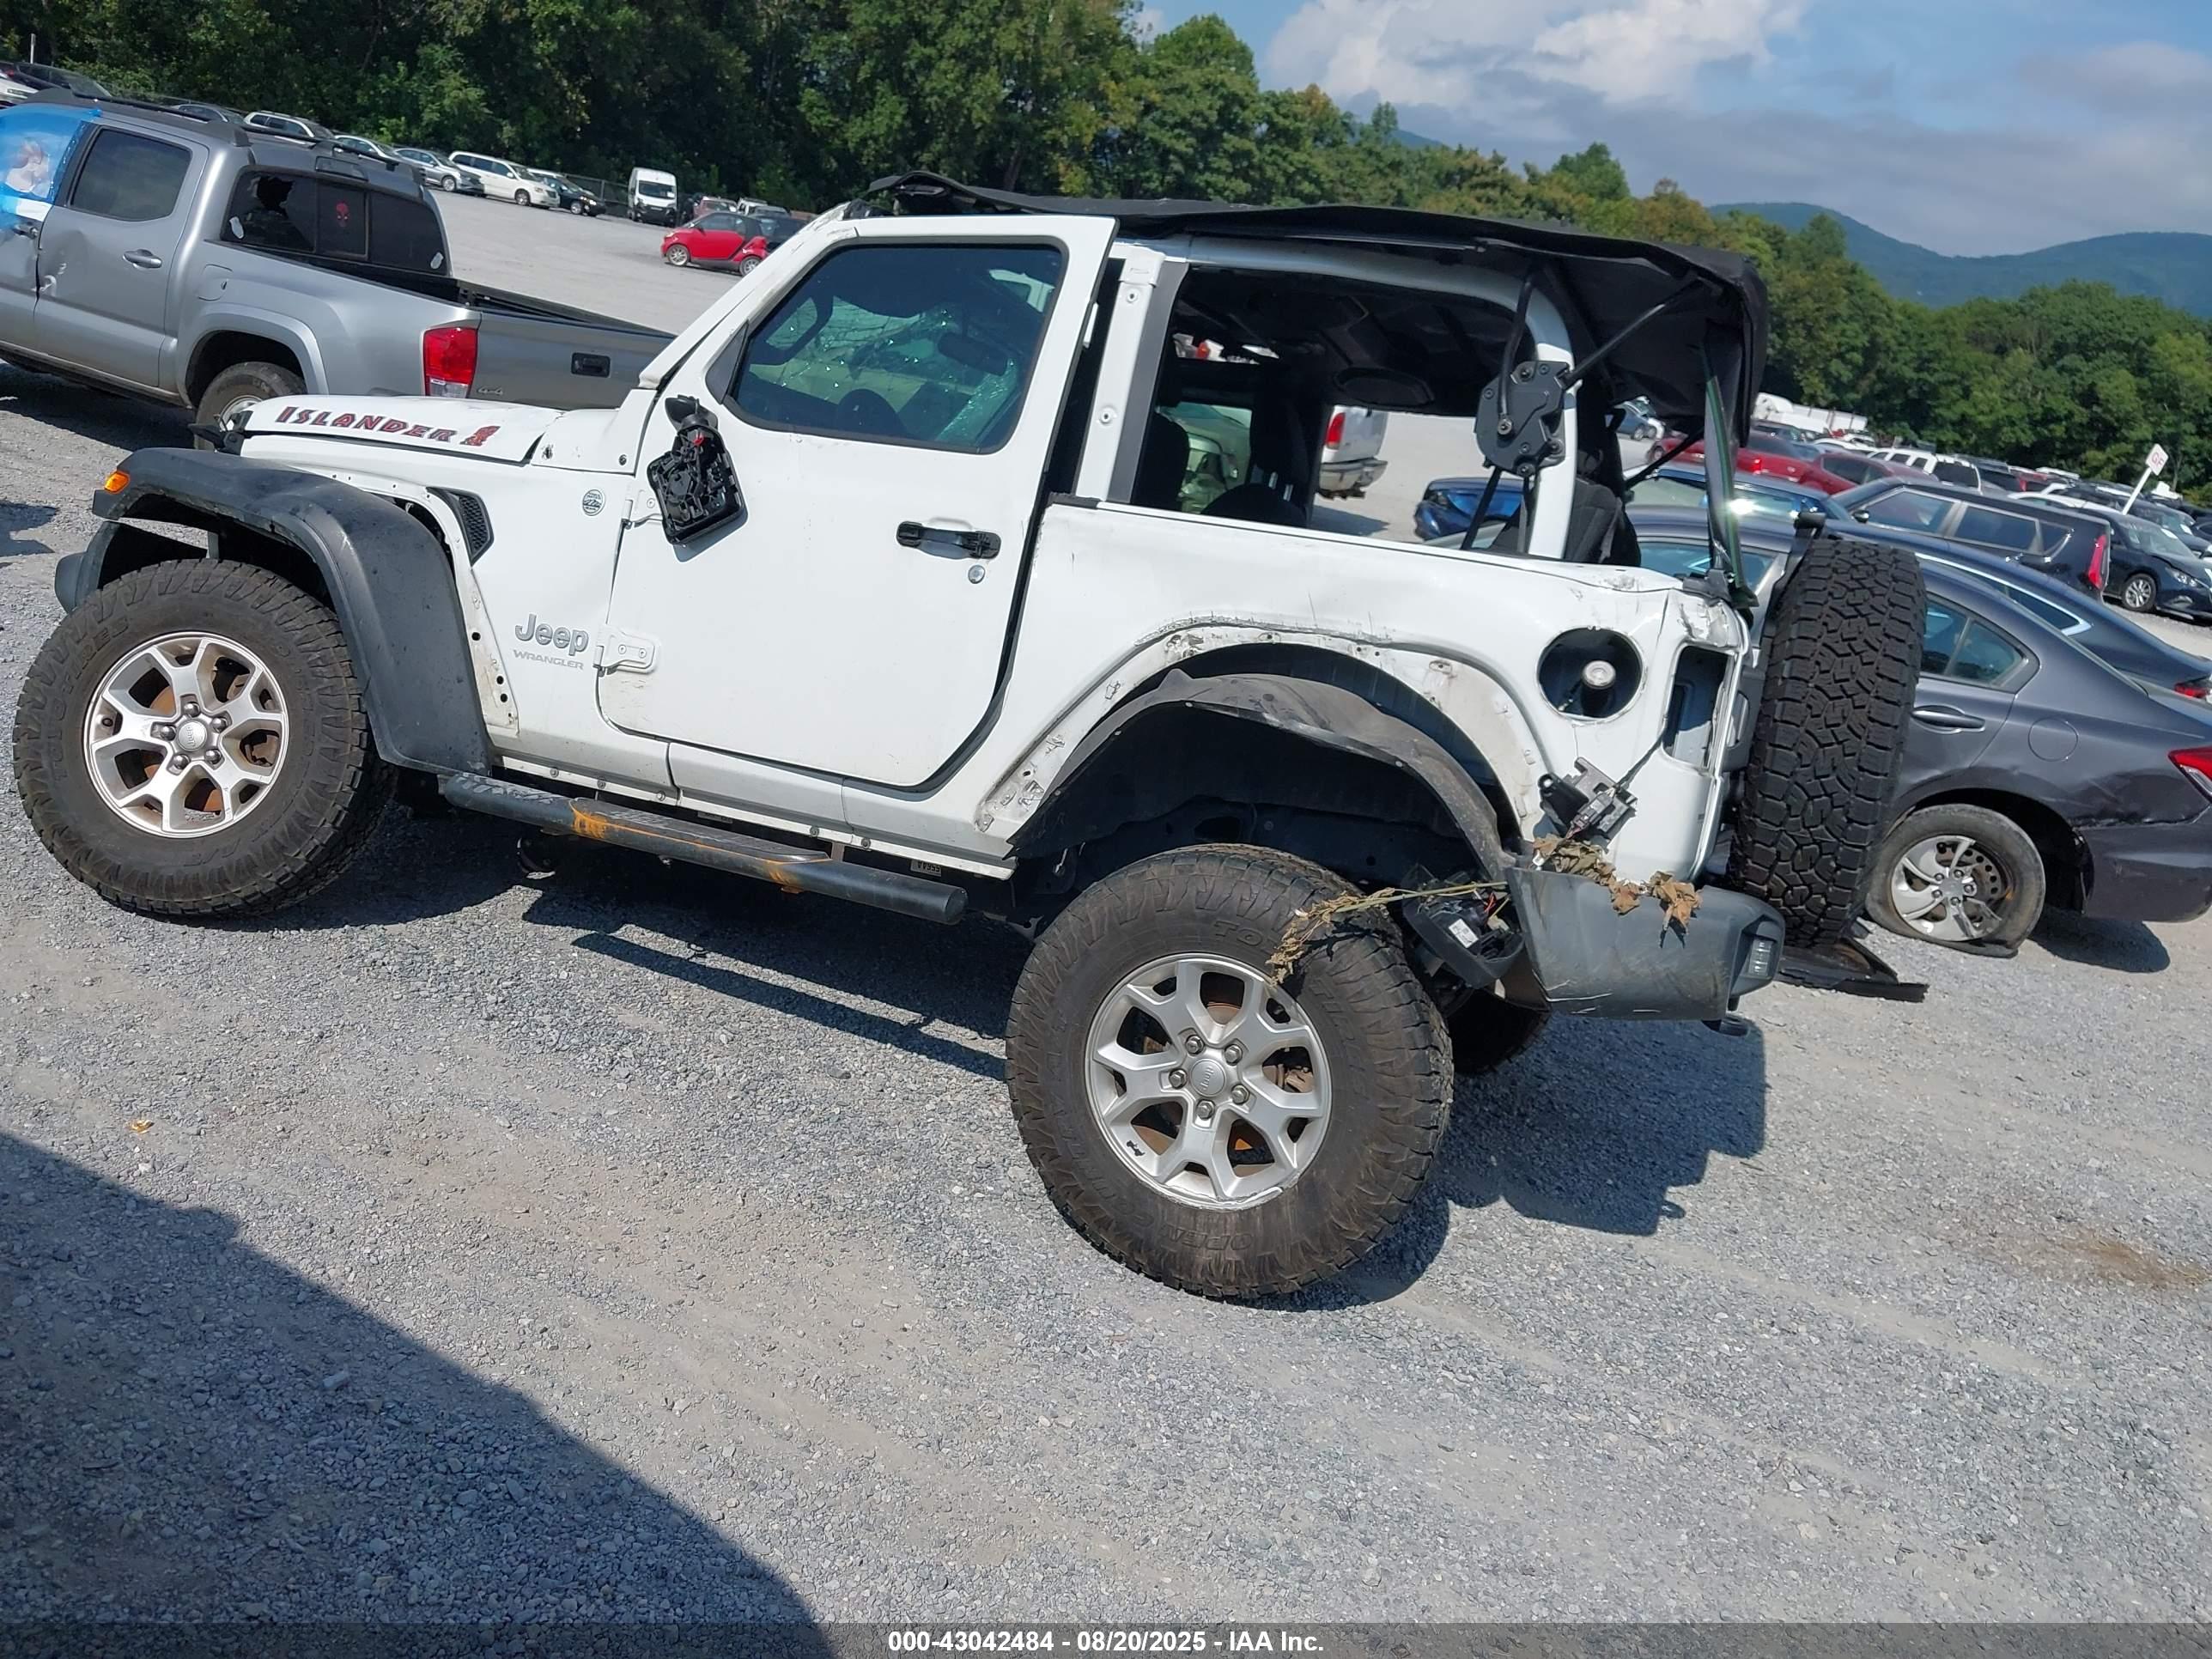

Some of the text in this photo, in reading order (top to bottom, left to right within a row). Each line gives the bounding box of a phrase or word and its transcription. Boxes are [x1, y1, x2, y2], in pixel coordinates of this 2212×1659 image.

[275, 406, 457, 442] ISLANDER
[514, 613, 589, 656] Jeep
[514, 649, 584, 671] WRANGLER
